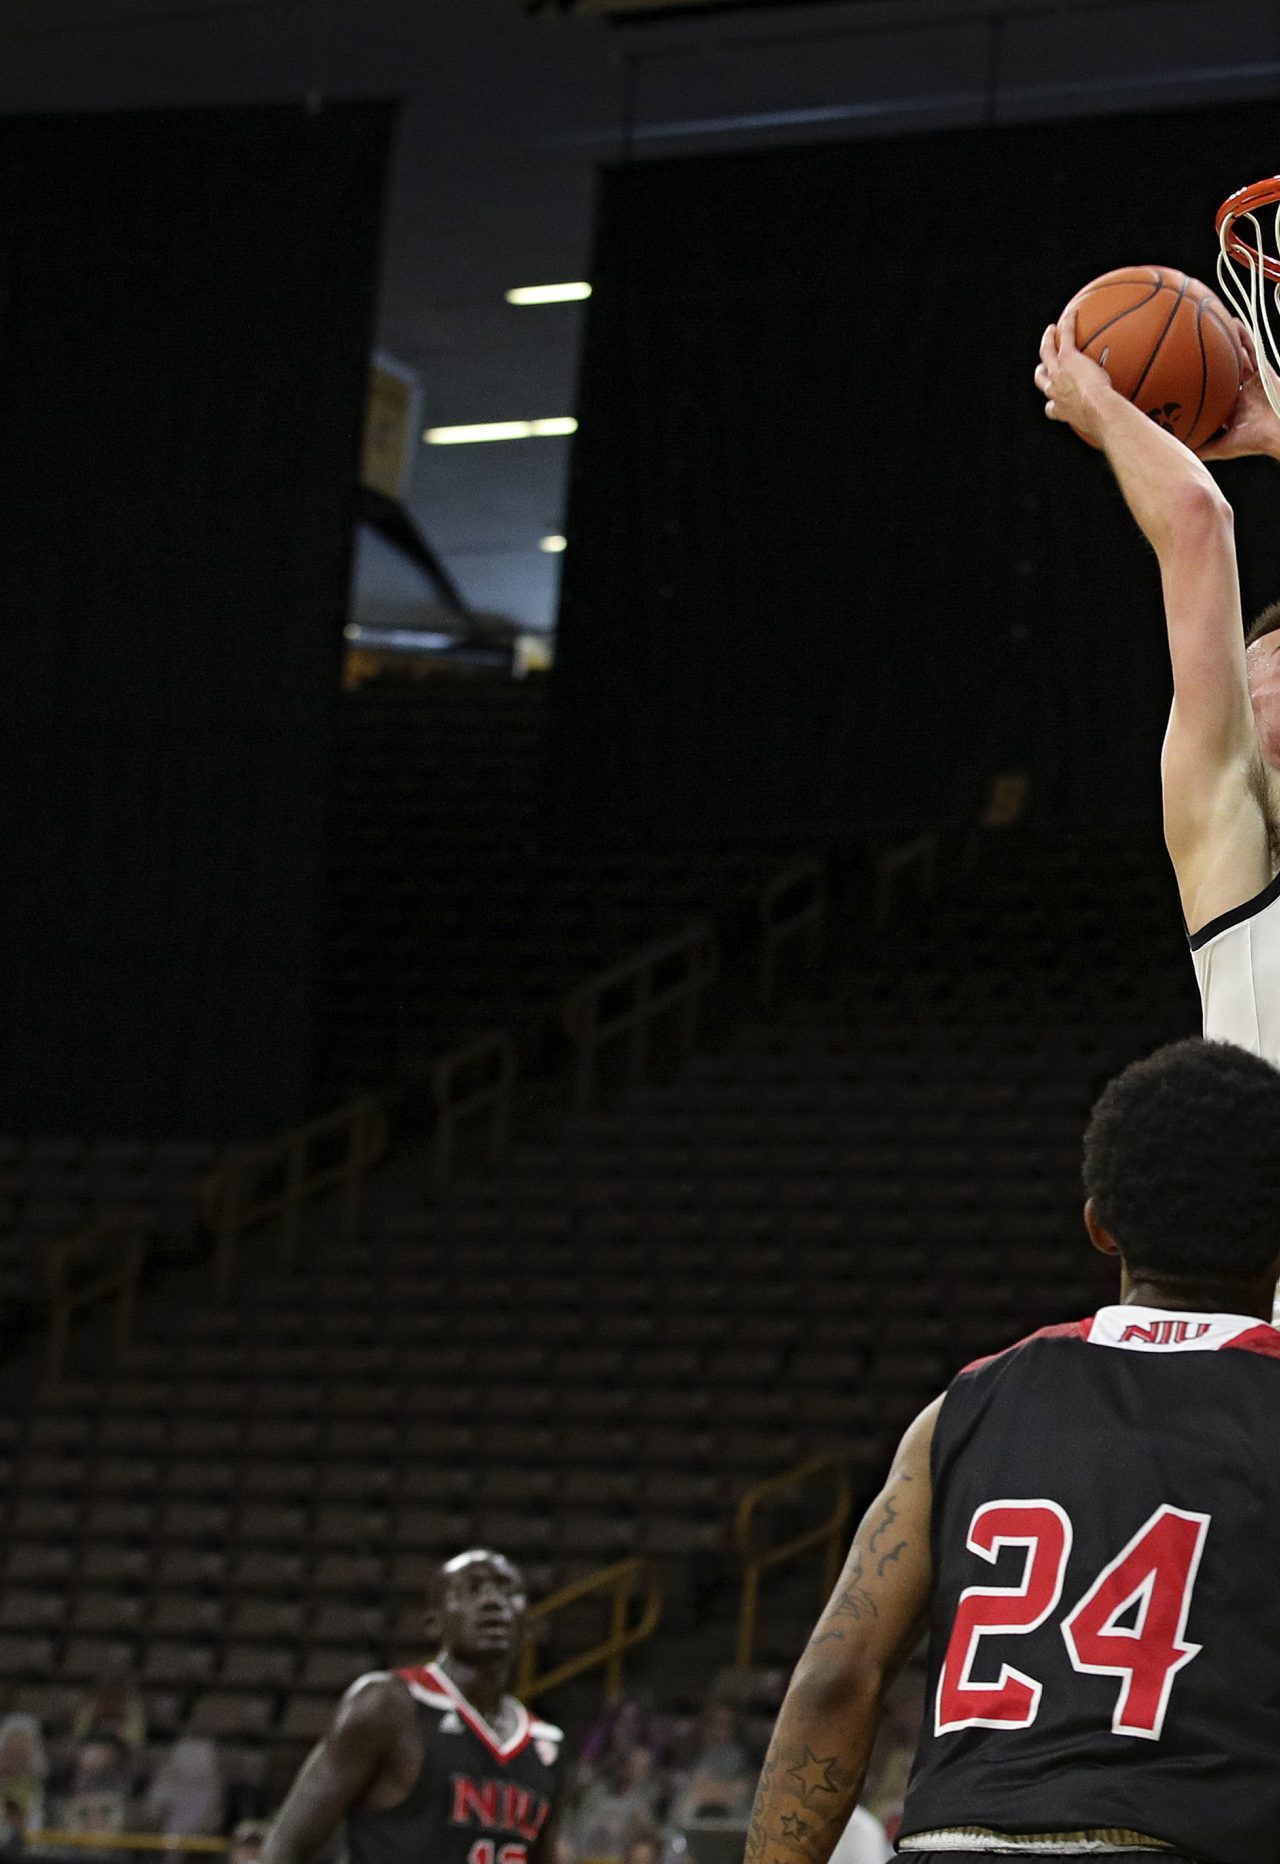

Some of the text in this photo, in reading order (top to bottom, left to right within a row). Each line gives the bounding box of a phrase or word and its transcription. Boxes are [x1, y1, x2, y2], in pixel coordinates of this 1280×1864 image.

[1118, 1320, 1212, 1345] NIU
[934, 1498, 1212, 1741] 24
[452, 1776, 549, 1841] NIU
